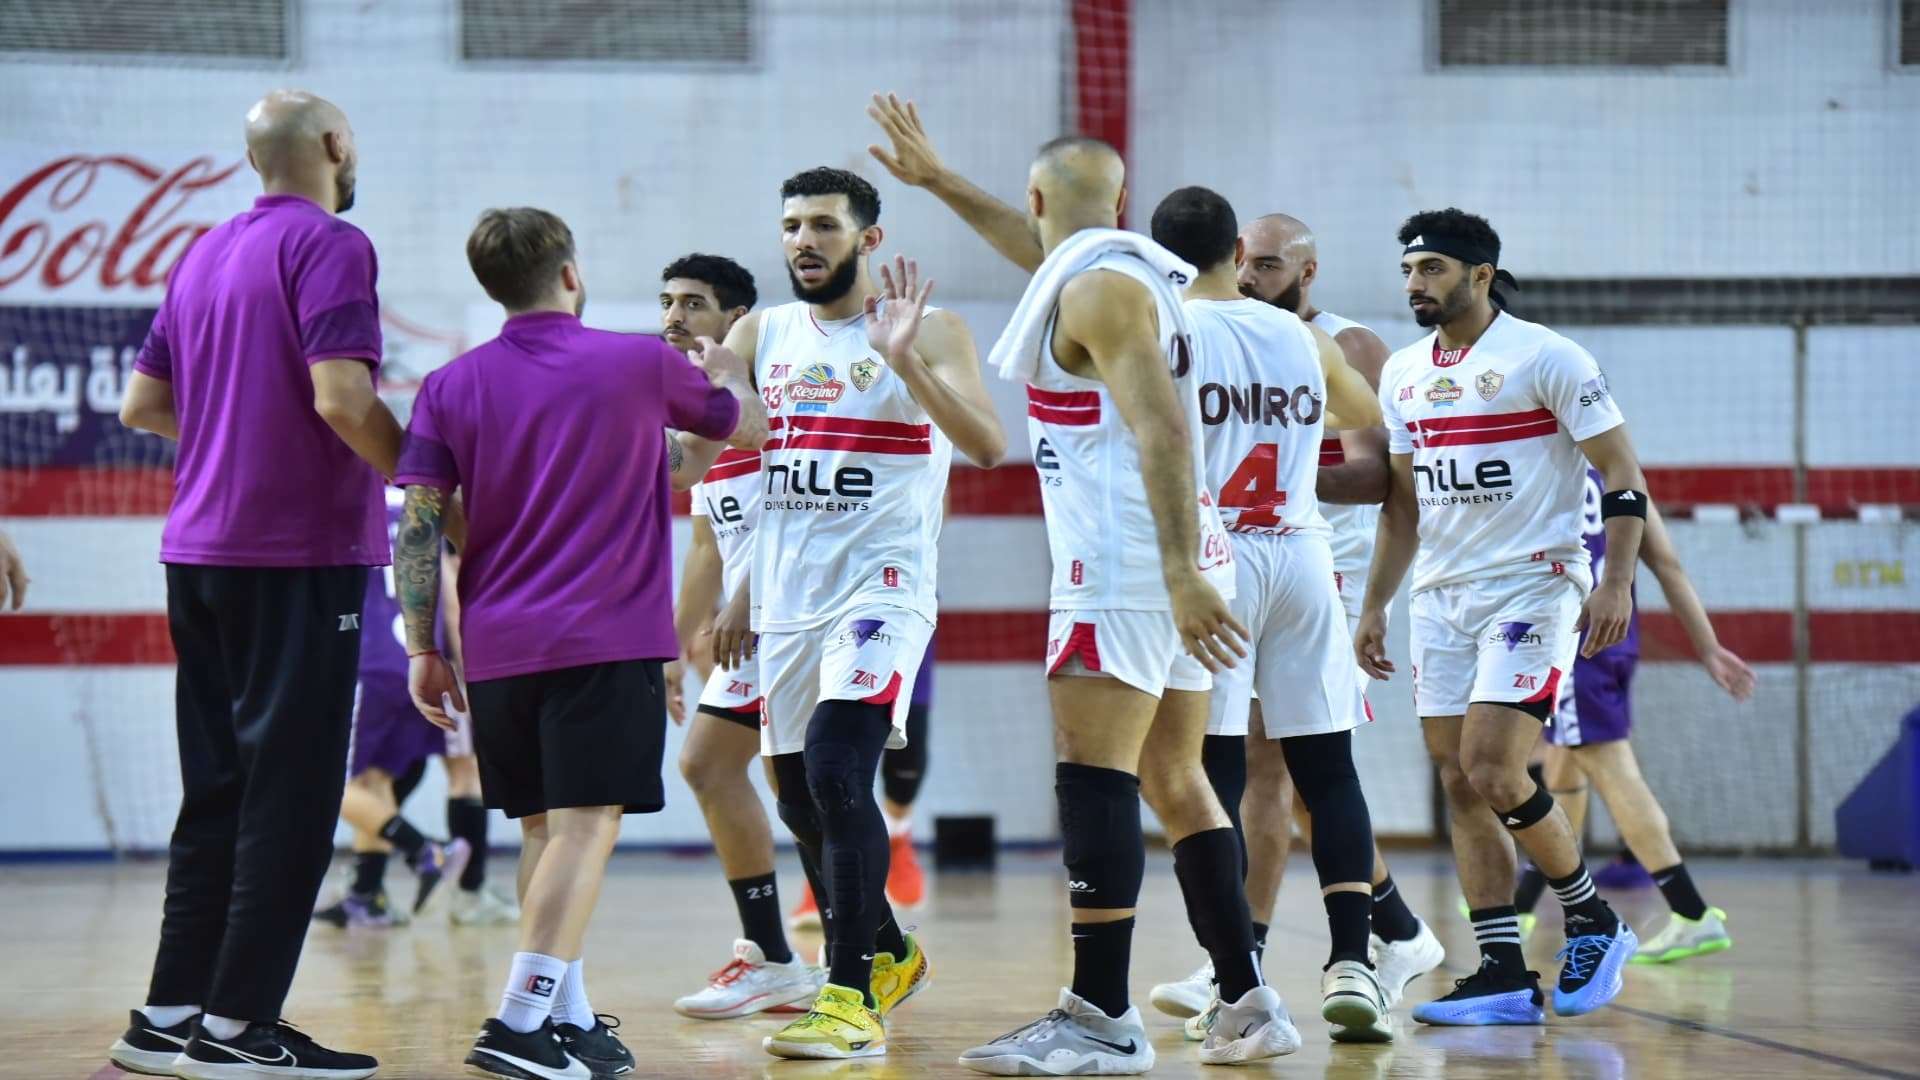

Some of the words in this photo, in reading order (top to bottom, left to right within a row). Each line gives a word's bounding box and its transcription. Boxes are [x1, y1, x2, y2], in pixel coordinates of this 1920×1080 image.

[0, 155, 243, 290] Cola
[1438, 350, 1462, 364] 1911
[790, 385, 839, 400] Regina
[1429, 390, 1460, 401] Regina
[1218, 442, 1287, 528] 4
[1420, 491, 1514, 507] EVELOPMENTS
[839, 630, 891, 646] seven
[1489, 631, 1542, 645] seven
[747, 884, 774, 899] 23
